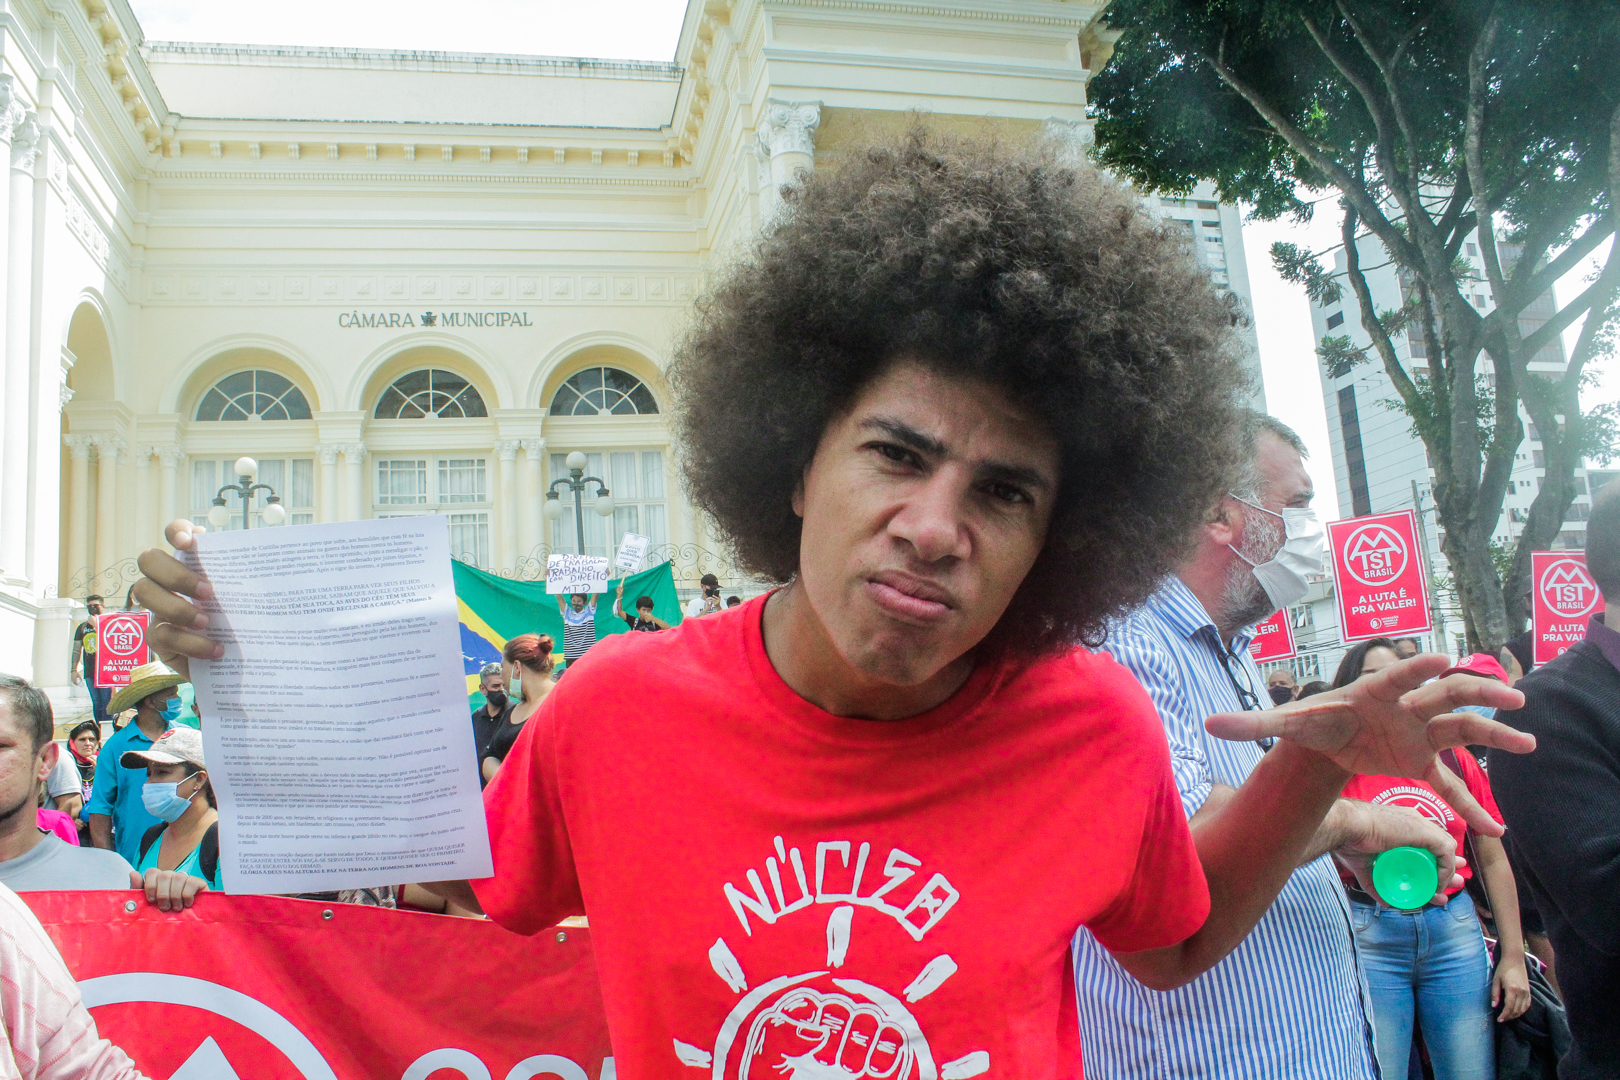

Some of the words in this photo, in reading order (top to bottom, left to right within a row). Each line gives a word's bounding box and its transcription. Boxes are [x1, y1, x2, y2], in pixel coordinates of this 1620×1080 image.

[338, 310, 415, 328] CÂMARA
[441, 312, 533, 327] MUNICIPAL
[548, 563, 594, 578] TRABALHO
[1364, 567, 1395, 579] BRASIL
[562, 584, 591, 594] MTD
[1358, 596, 1367, 604] A
[1368, 590, 1396, 602] LUTA
[1399, 587, 1408, 598] É
[1352, 604, 1375, 615] PRA
[1378, 598, 1417, 612] VALER!
[1556, 602, 1586, 610] BRASIL
[1550, 624, 1557, 632] A
[1558, 624, 1586, 632] LUTA
[1542, 633, 1564, 642] PRA
[134, 658, 138, 666] É
[1390, 786, 1436, 802] TRABALHADORES
[1434, 798, 1447, 810] SEM
